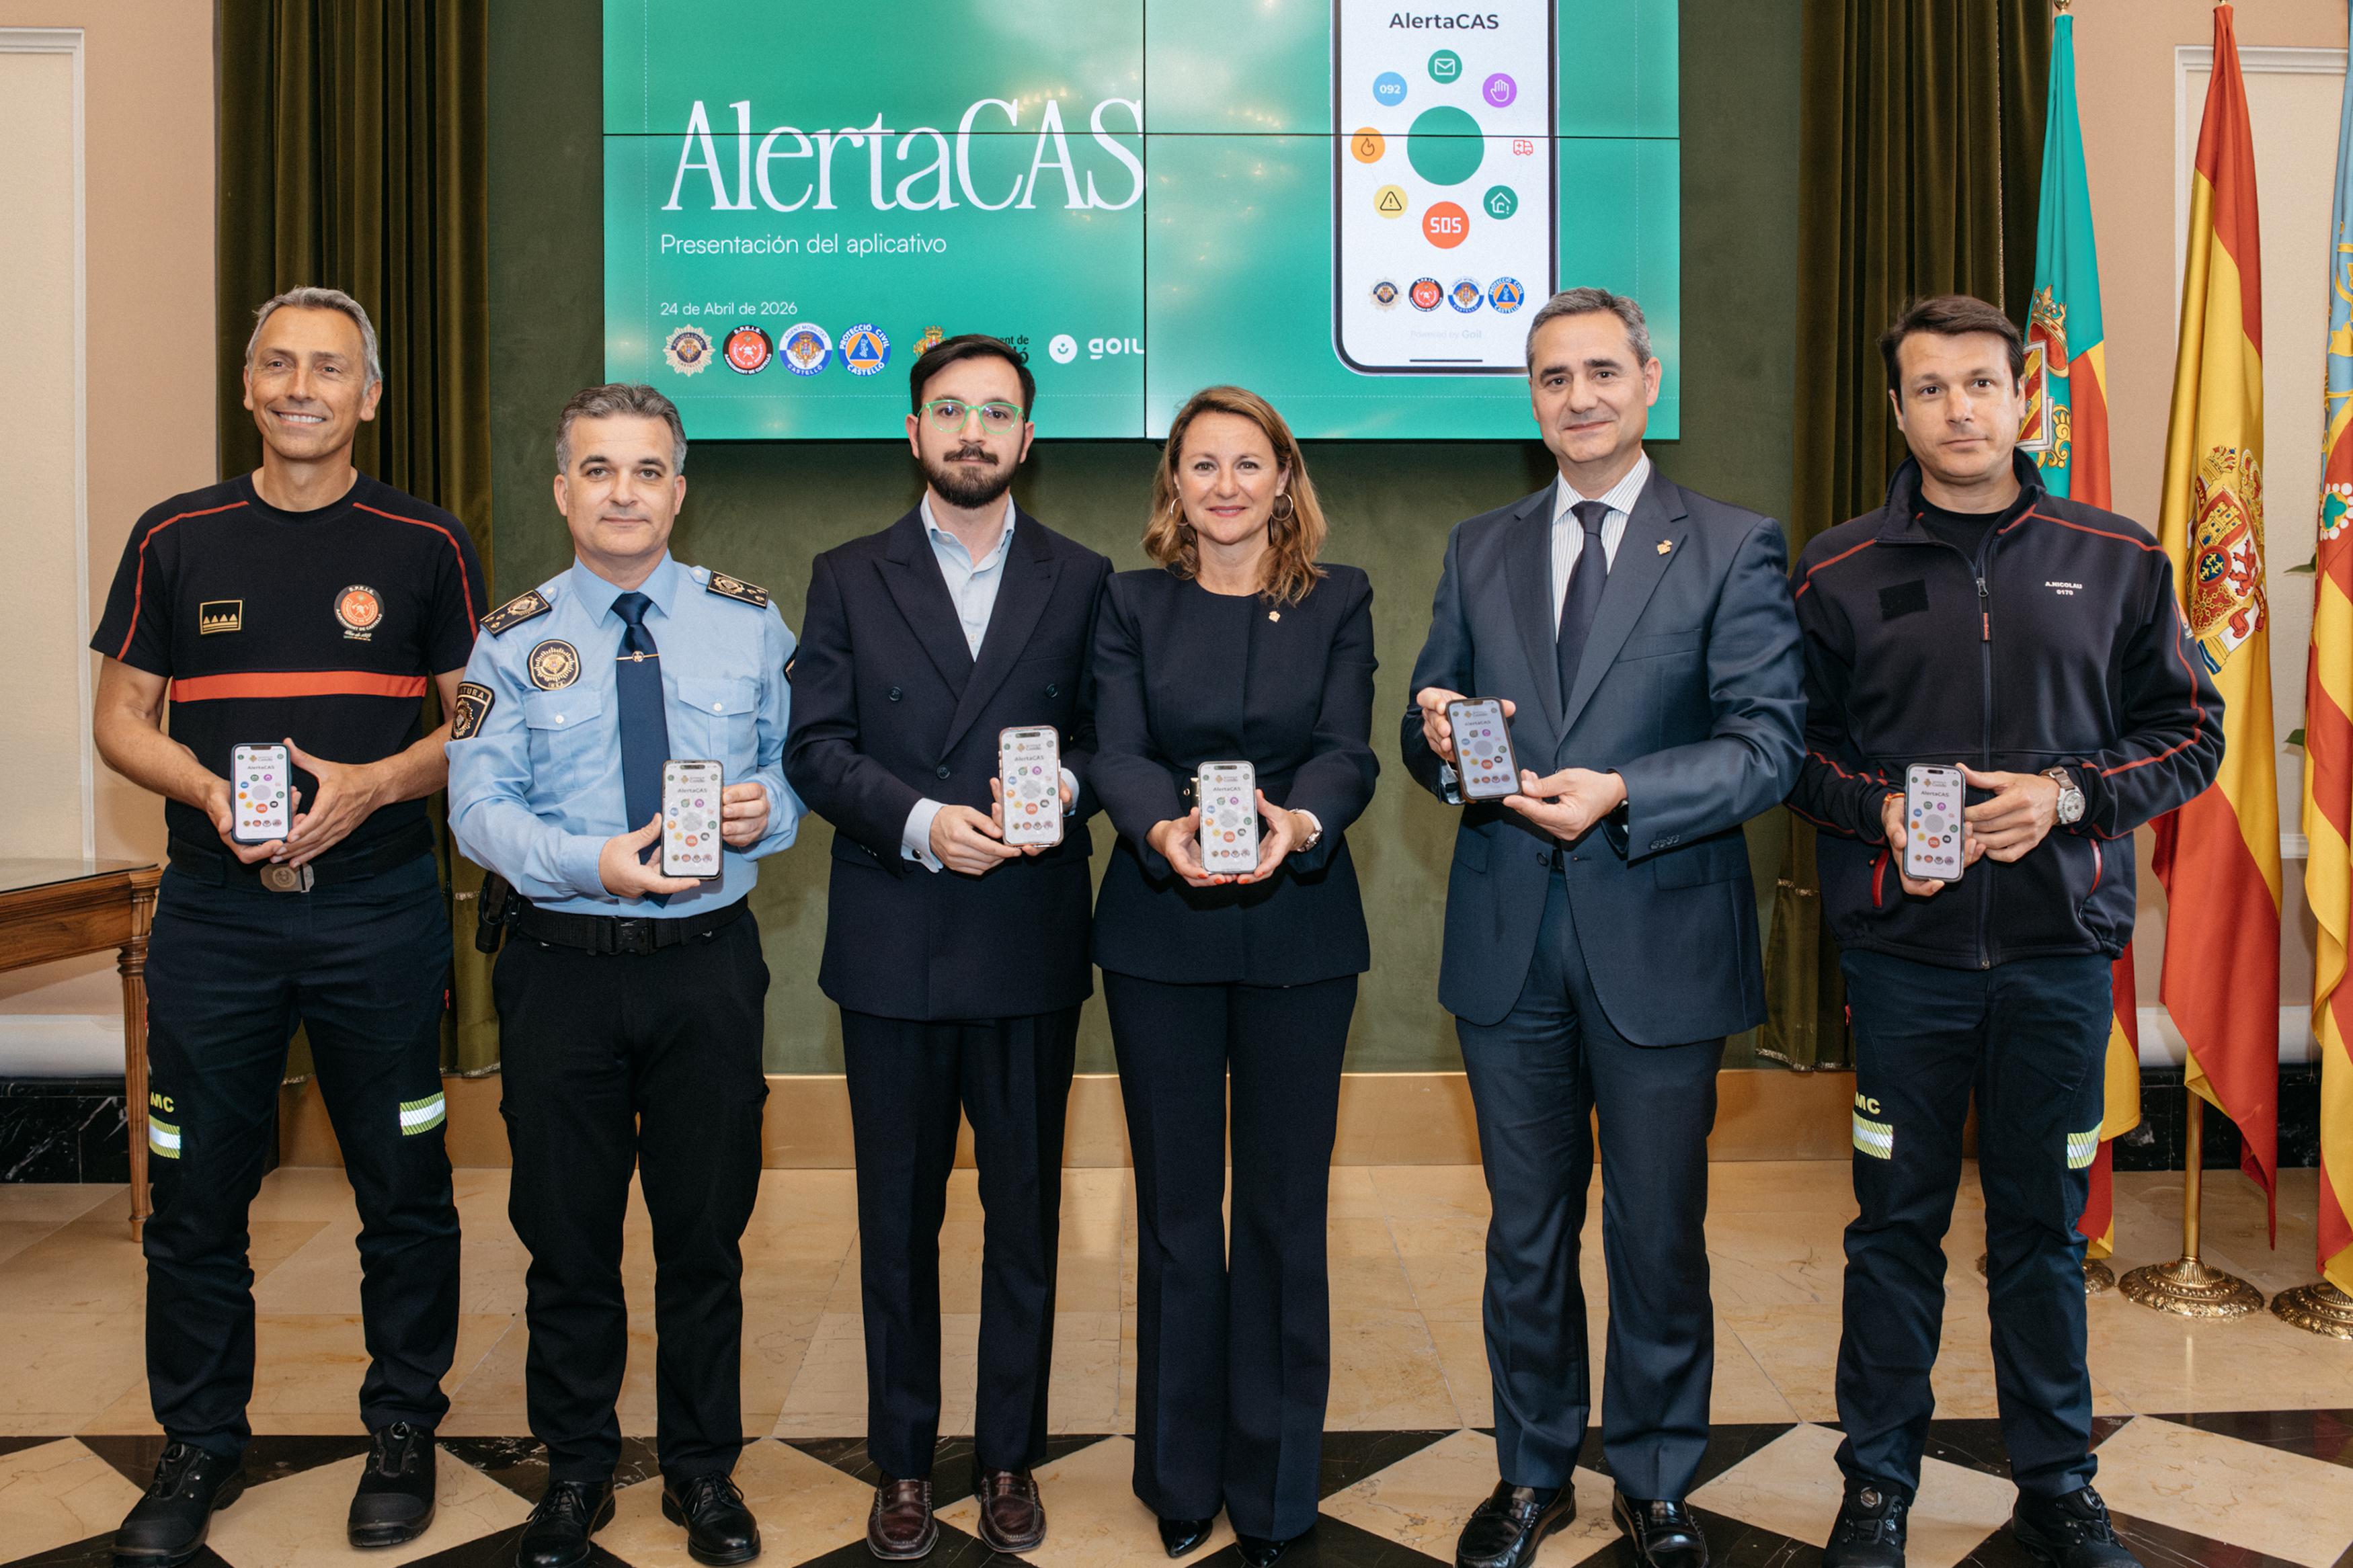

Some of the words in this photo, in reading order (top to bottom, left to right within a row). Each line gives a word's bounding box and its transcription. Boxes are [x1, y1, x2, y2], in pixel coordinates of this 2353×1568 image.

[1389, 12, 1499, 30] AlertaCAS
[1380, 85, 1401, 94] 092
[661, 98, 1144, 212] AlertaCAS
[1430, 217, 1462, 233] SOS
[661, 234, 799, 254] Presentación
[807, 233, 838, 253] del
[846, 233, 947, 258] aplicativo
[660, 302, 678, 315] 24
[682, 302, 701, 315] de
[704, 302, 735, 315] Abril
[739, 302, 756, 315] de
[760, 302, 798, 315] 2026
[785, 326, 801, 339] AGENT
[802, 325, 828, 340] MOBILITAT
[838, 323, 873, 350] PROTECCIÓ
[875, 329, 890, 349] CIVIL
[1016, 335, 1029, 345] de
